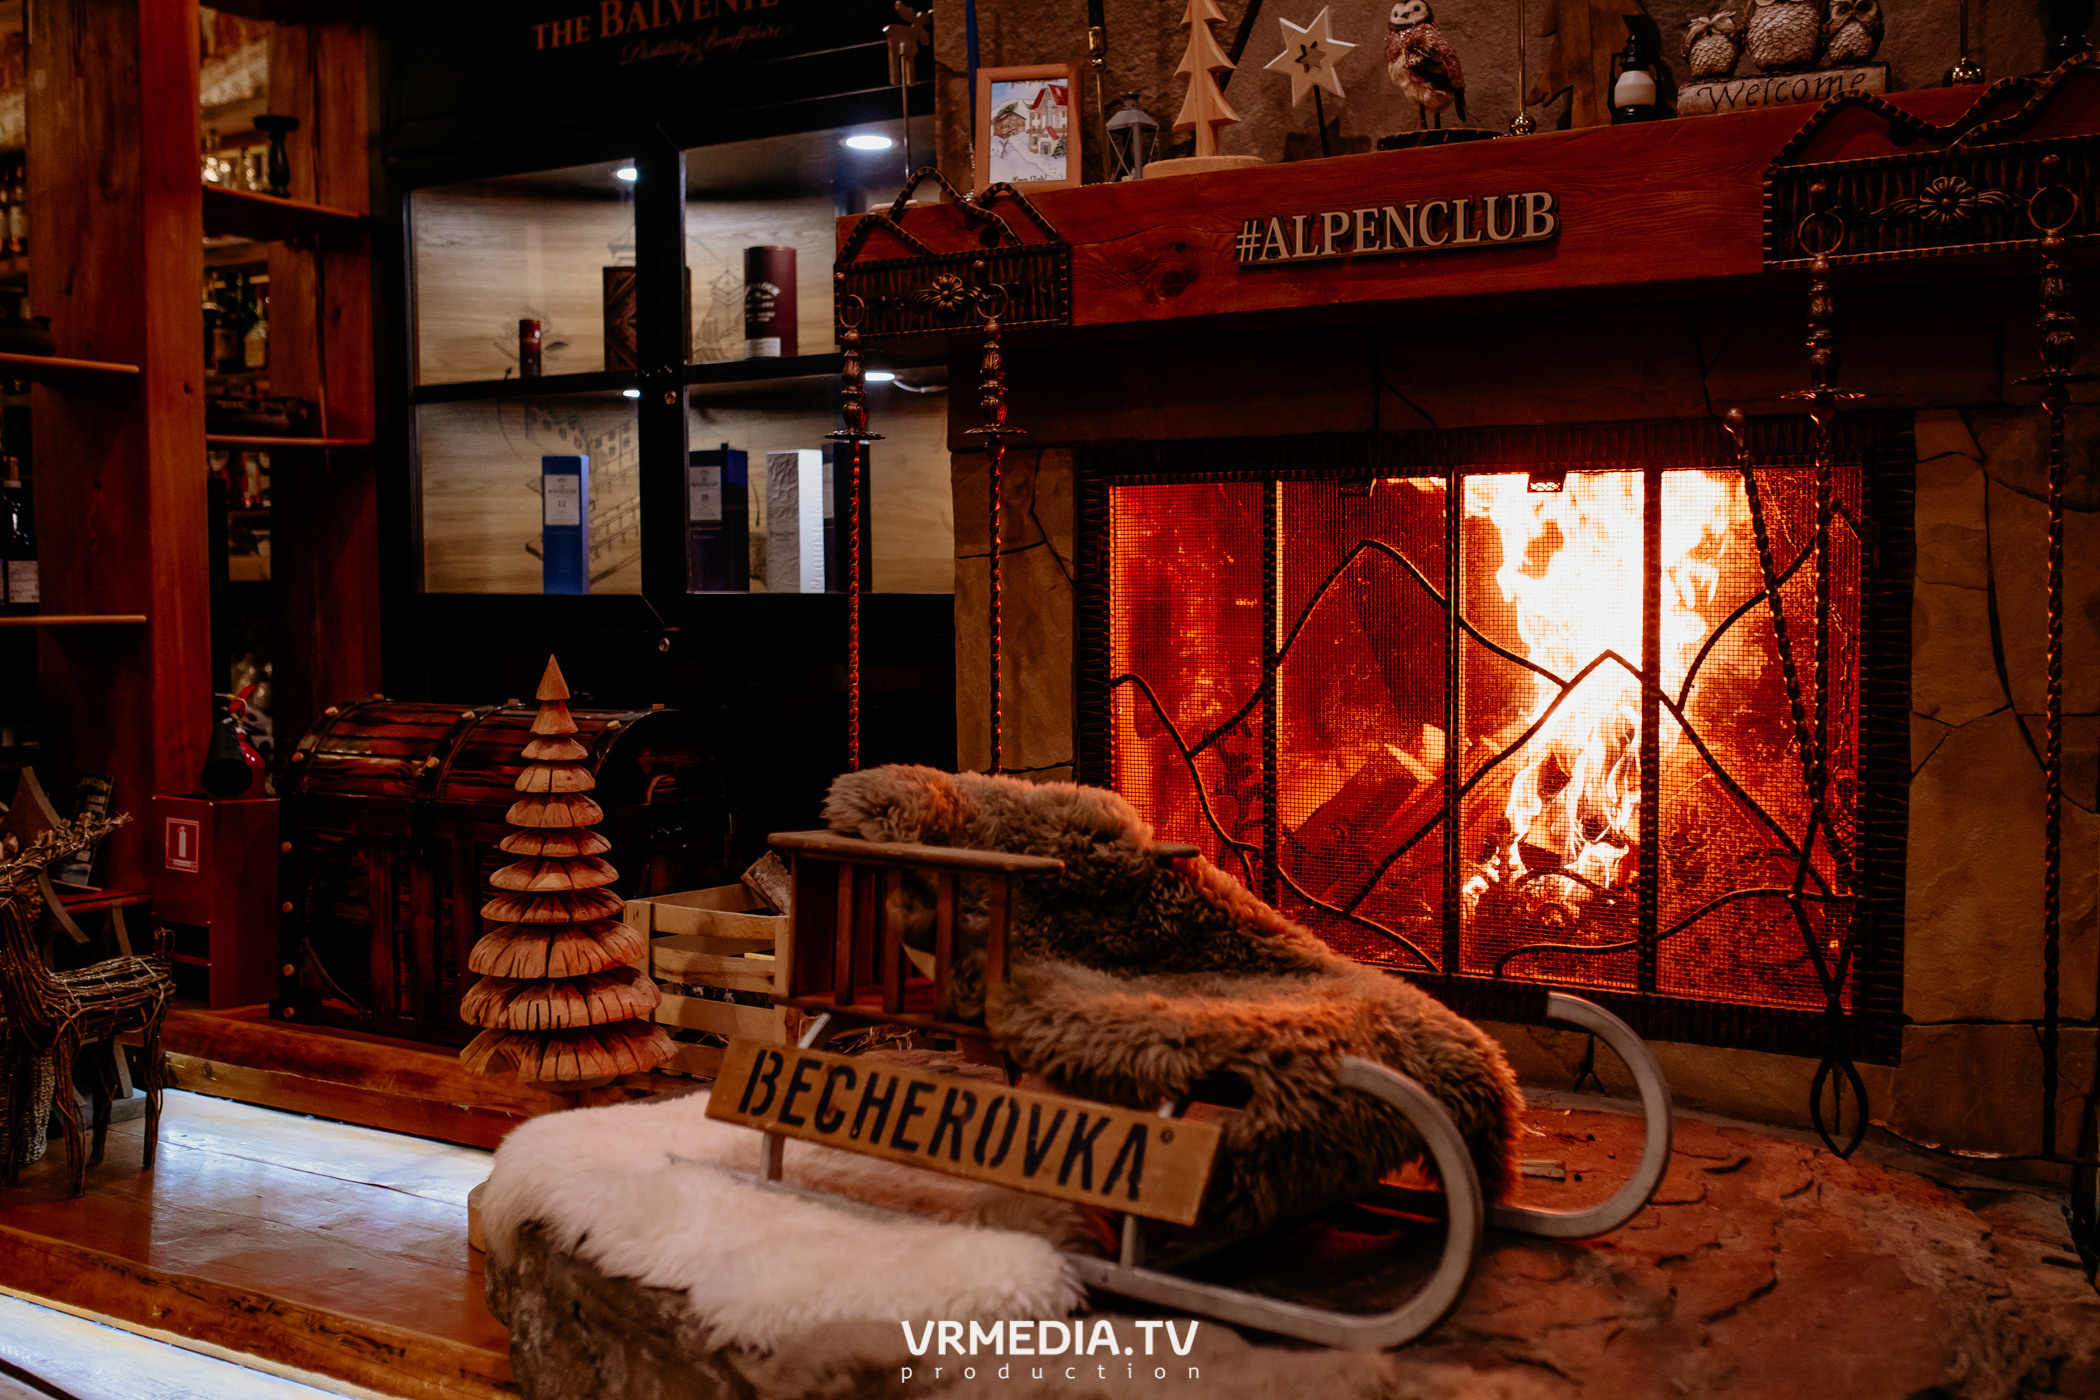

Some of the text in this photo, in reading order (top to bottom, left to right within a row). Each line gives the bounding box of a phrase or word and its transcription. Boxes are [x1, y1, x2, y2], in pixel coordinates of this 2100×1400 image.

[531, 14, 592, 51] THE
[1697, 72, 1866, 111] Welcome
[1235, 191, 1557, 263] #ALPENCLUB
